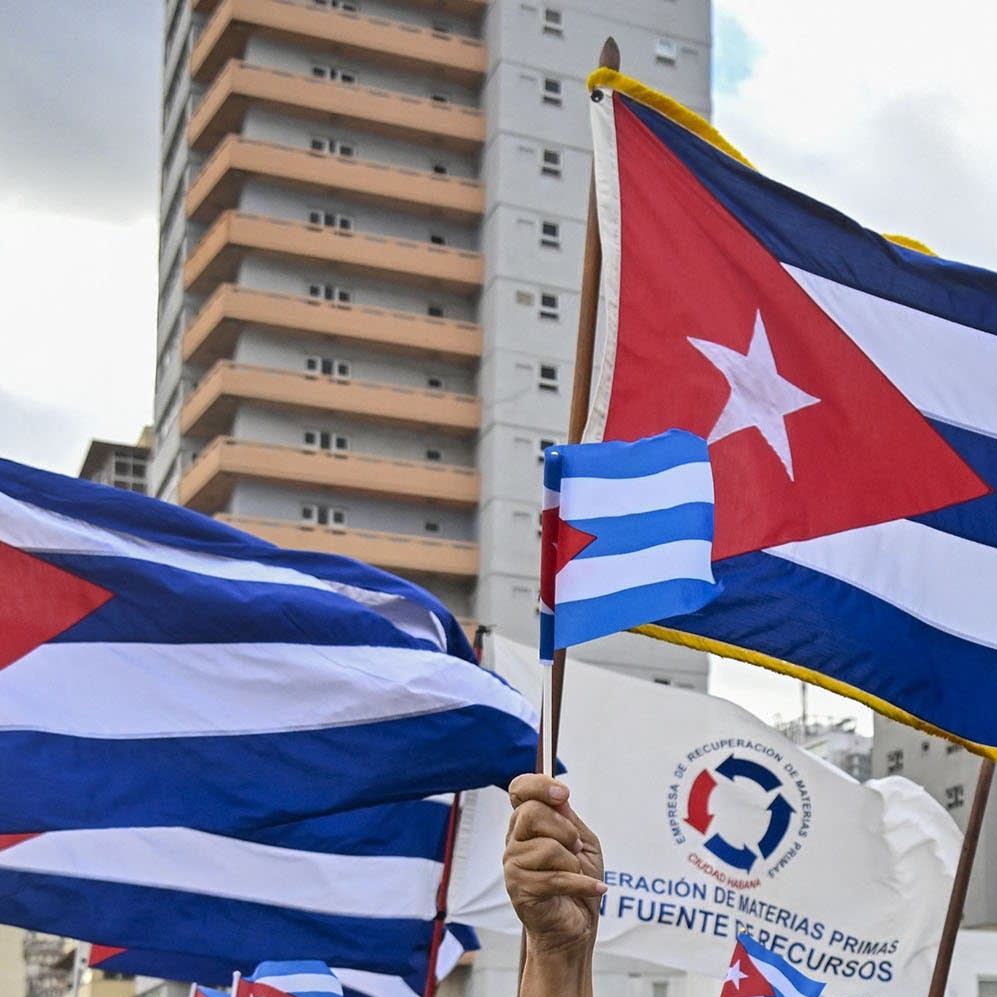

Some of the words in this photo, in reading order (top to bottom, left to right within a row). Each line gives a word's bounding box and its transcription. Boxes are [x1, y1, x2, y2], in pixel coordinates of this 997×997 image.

[674, 763, 687, 779] DE
[784, 763, 799, 779] DE
[667, 784, 686, 845] EMPRESA
[795, 780, 813, 838] MATERIAS
[687, 852, 727, 883] CIUDAD
[726, 877, 762, 890] HABANA
[768, 842, 803, 879] PRIMAS
[617, 895, 729, 938] FUENTE
[759, 929, 893, 983] RECURSOS
[714, 886, 735, 908] DE
[739, 893, 826, 941] MATERIAS
[827, 930, 899, 955] PRIMAS
